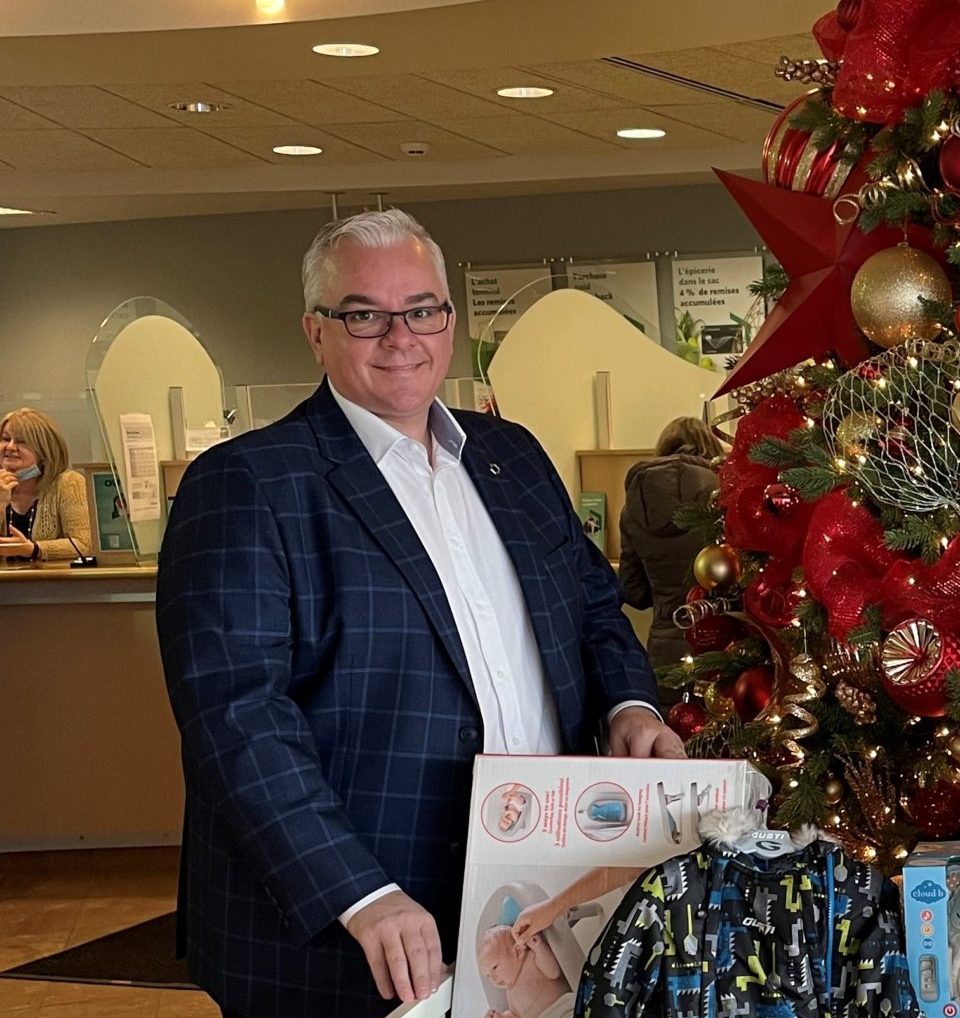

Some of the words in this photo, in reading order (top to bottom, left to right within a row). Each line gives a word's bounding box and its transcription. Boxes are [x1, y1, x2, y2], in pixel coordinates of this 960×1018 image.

[710, 286, 739, 295] remises
[680, 298, 725, 307] accumulées
[912, 889, 936, 898] cloud
